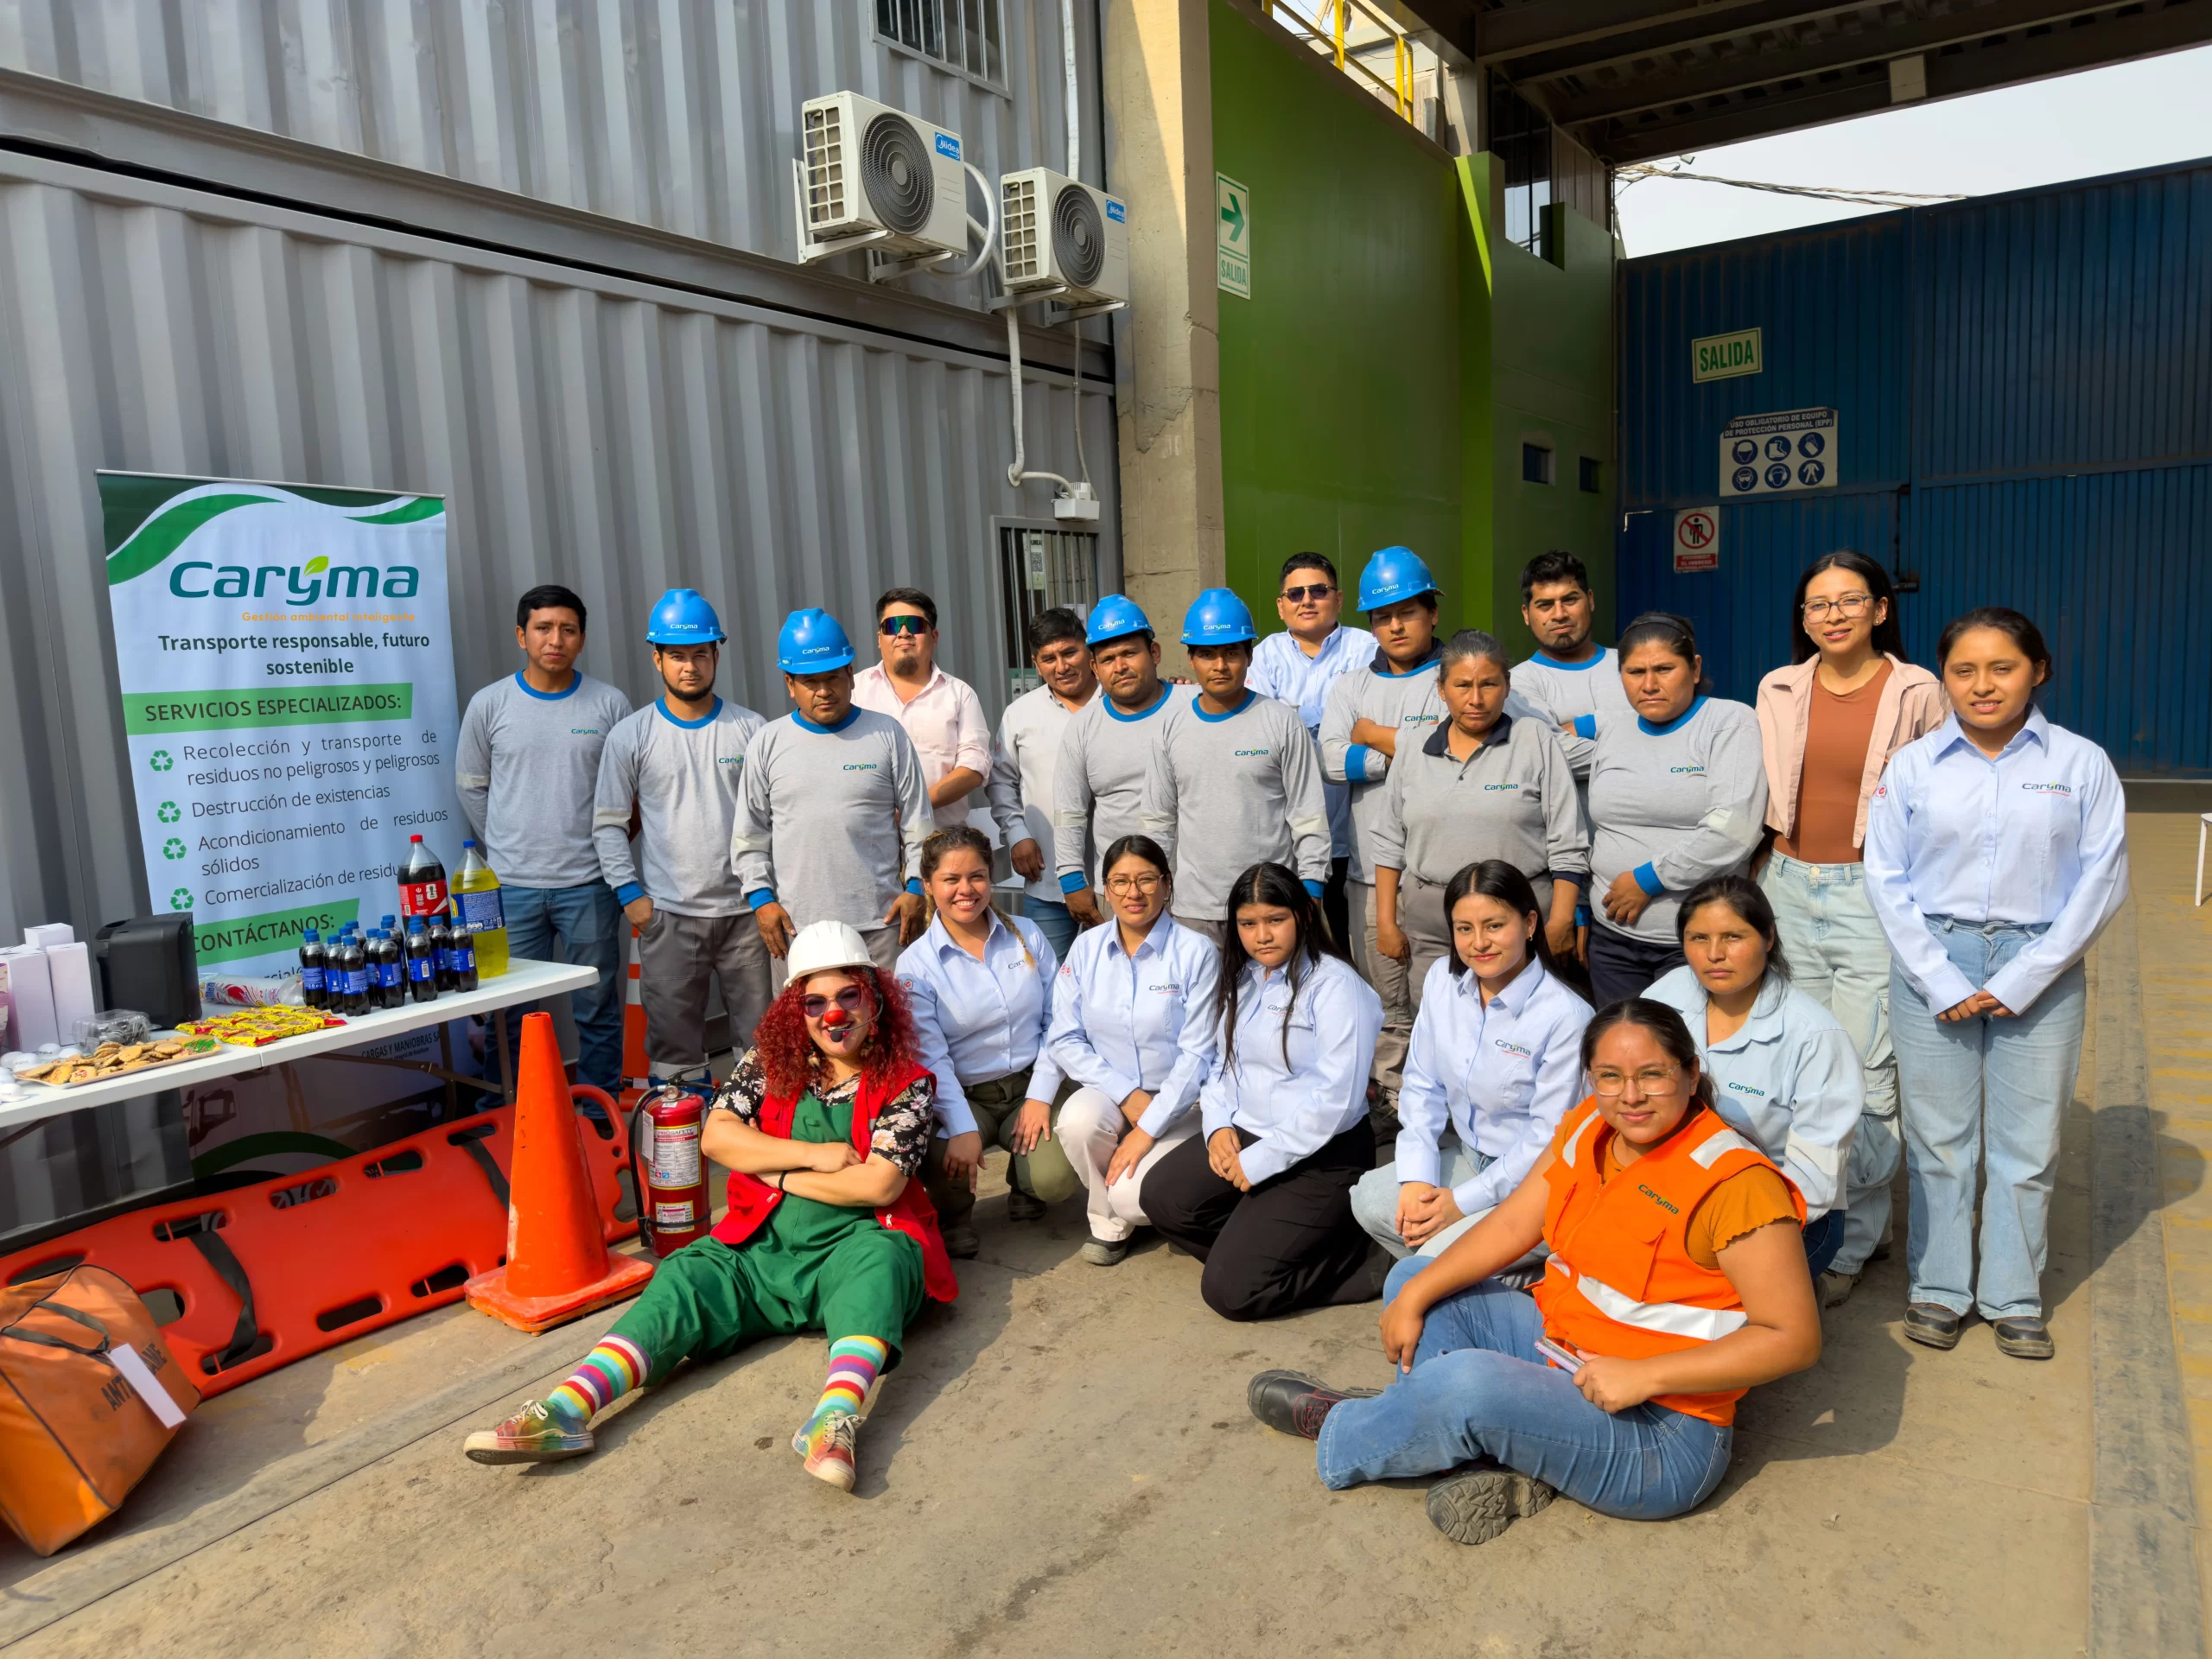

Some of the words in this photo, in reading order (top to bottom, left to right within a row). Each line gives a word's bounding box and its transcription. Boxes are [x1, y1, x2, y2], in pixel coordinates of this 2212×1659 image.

[936, 134, 960, 154] Midea
[1221, 260, 1247, 286] SALIDA
[1700, 339, 1754, 372] SALIDA
[1735, 424, 1777, 436] PROTECCIÓN
[1778, 420, 1814, 430] PERSONAL
[1815, 418, 1833, 427] (EPP)
[1745, 416, 1789, 427] OBLIGATORIO
[1802, 411, 1827, 420] EQUIPO
[169, 557, 419, 606] Caryma
[1371, 583, 1399, 594] Caryma
[242, 612, 287, 621] Gestión
[290, 612, 349, 621] ambiental
[353, 612, 416, 624] inteligente
[1098, 620, 1125, 630] Caryma
[158, 635, 268, 654] Transporte
[272, 632, 378, 652] responsable,
[383, 632, 429, 647] futuro
[802, 646, 830, 655] Caryma
[266, 658, 354, 675] sostenible
[145, 700, 252, 722] SERVICIOS
[257, 694, 402, 715] ESPECIALIZADOS:
[184, 739, 290, 760] Recolección
[302, 740, 311, 756] y
[321, 733, 402, 751] transporte
[422, 729, 437, 744] de
[188, 767, 259, 785] residuos
[264, 766, 282, 779] no
[287, 760, 359, 781] peligrosos
[362, 759, 372, 774] y
[375, 753, 440, 771] peligrosos
[2022, 783, 2071, 792] Caryma
[192, 793, 287, 817] Destrucción
[291, 791, 311, 807] de
[315, 785, 391, 804] existencias
[198, 821, 346, 851] Acondicionamiento
[359, 817, 378, 831] de
[393, 808, 448, 827] residuos
[202, 856, 260, 876] sólidos
[205, 873, 334, 906] Comercialización
[338, 870, 355, 884] de
[359, 862, 399, 881] residu
[389, 1044, 393, 1055] Y
[394, 1033, 433, 1052] MANIOBRAS
[1495, 1039, 1531, 1055] Caryma
[1728, 1082, 1764, 1096] Caryma
[1638, 1184, 1679, 1215] Caryma
